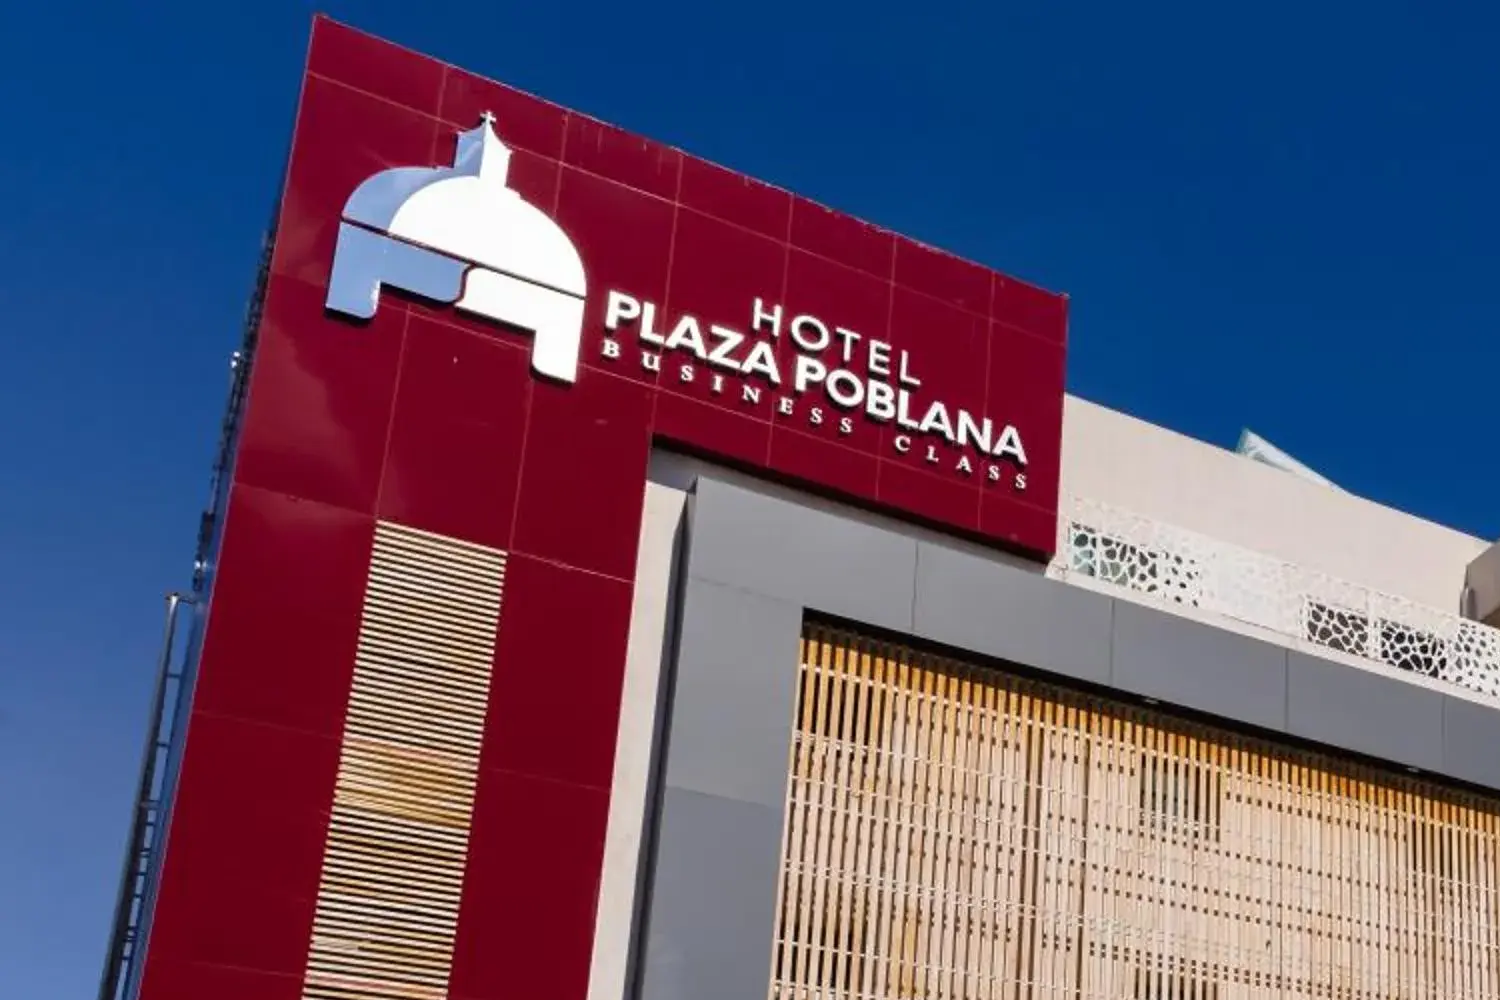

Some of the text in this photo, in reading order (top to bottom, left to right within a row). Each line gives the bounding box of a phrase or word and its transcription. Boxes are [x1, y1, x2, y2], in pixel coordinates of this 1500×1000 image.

[601, 338, 1028, 491] BUSINESS CLASS
[604, 290, 1028, 465] PLAZA POBLANA
[752, 297, 921, 386] HOTEL
